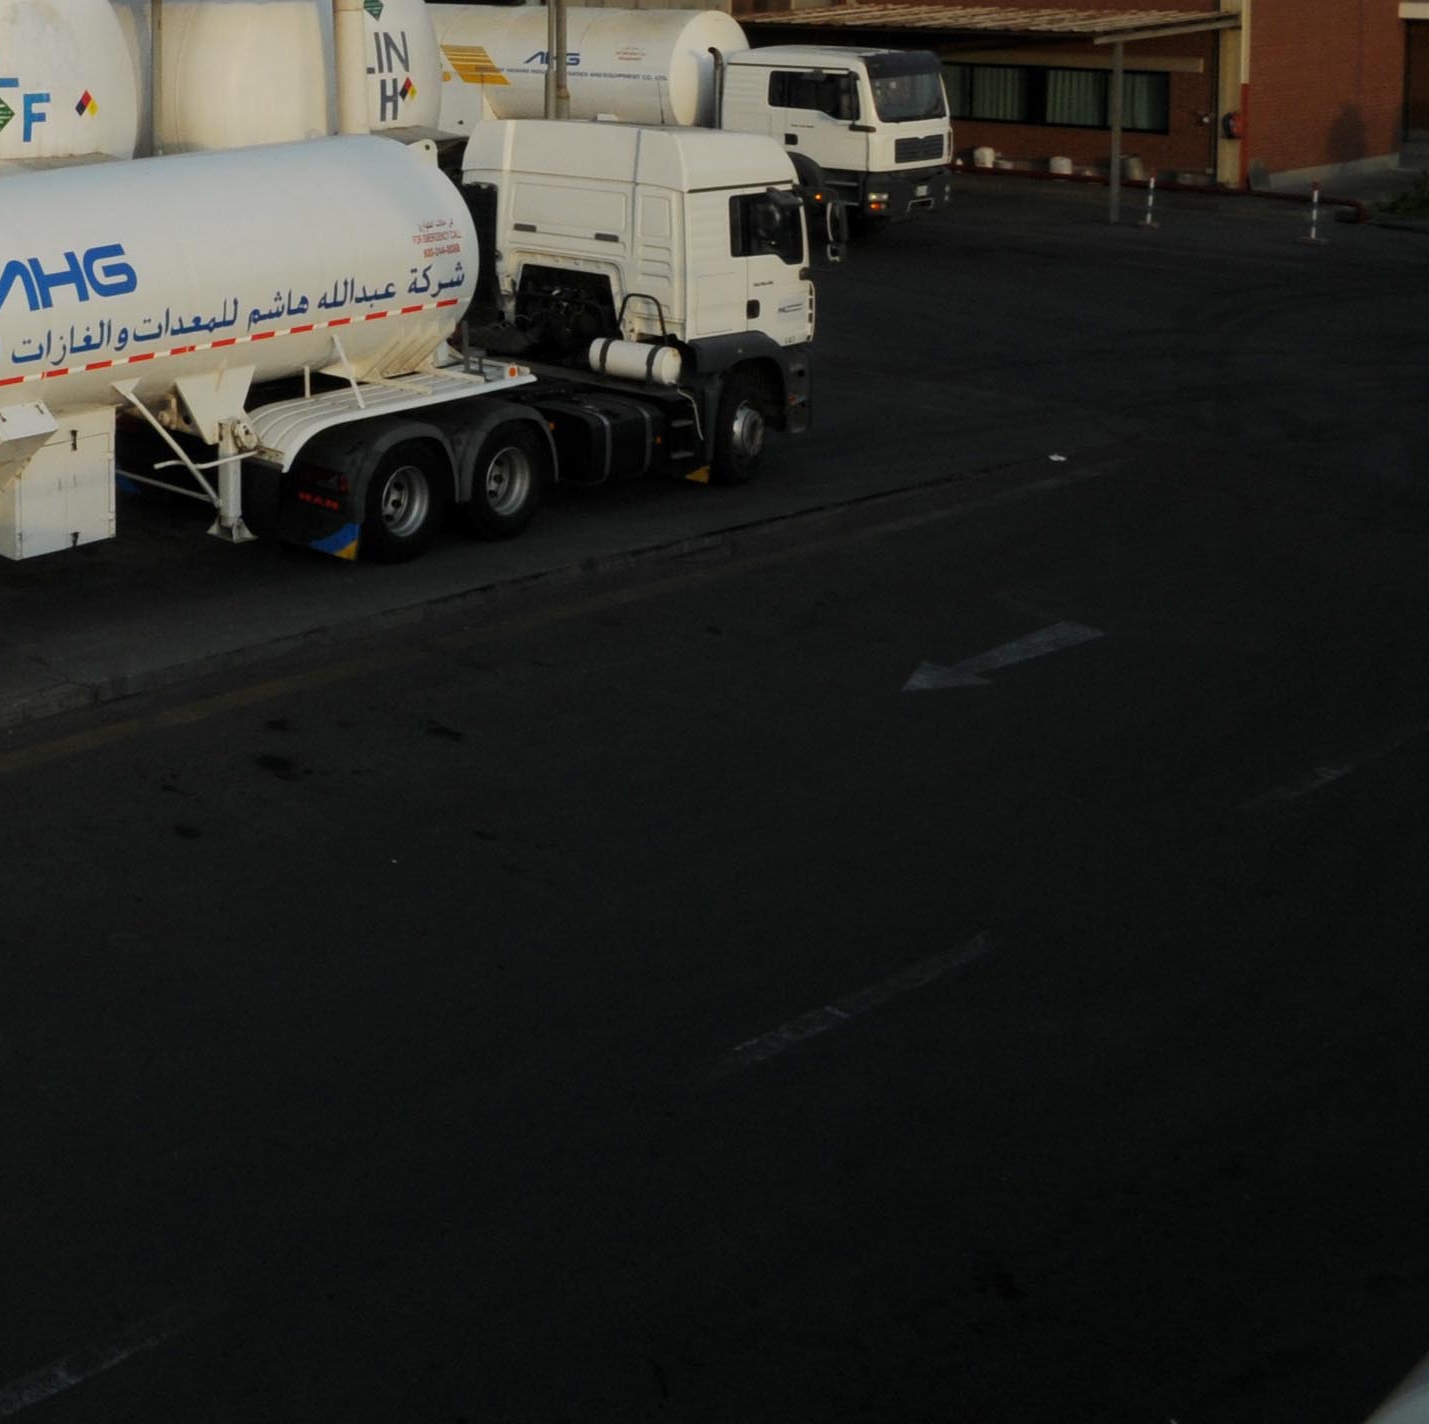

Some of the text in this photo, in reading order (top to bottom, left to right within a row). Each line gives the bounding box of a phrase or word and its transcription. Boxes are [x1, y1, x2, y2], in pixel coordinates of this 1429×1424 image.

[366, 31, 409, 74] IN
[23, 93, 50, 142] F
[380, 78, 398, 122] H
[317, 277, 397, 311] عبدالله
[407, 261, 465, 298] شركة
[133, 297, 238, 341] للمعدات
[247, 288, 309, 332] هاشم
